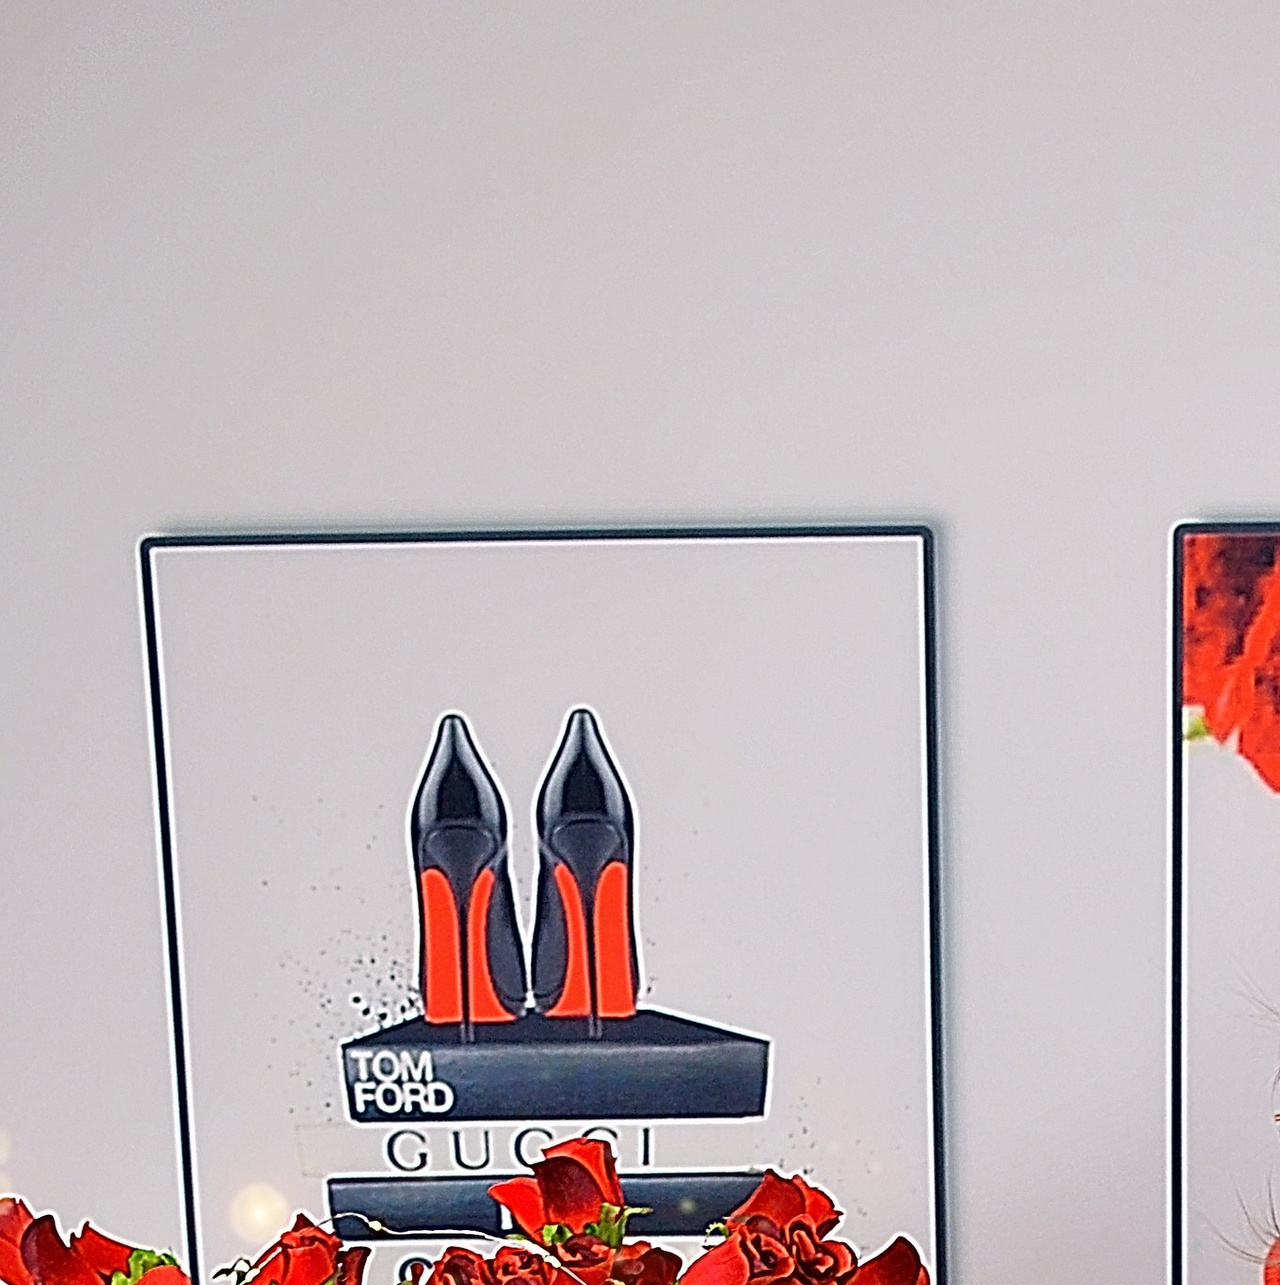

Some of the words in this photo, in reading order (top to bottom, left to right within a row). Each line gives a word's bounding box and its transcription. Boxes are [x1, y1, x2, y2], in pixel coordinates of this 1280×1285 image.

[350, 1051, 433, 1083] TOM
[354, 1081, 455, 1115] FORD
[386, 1126, 652, 1172] GUCI
